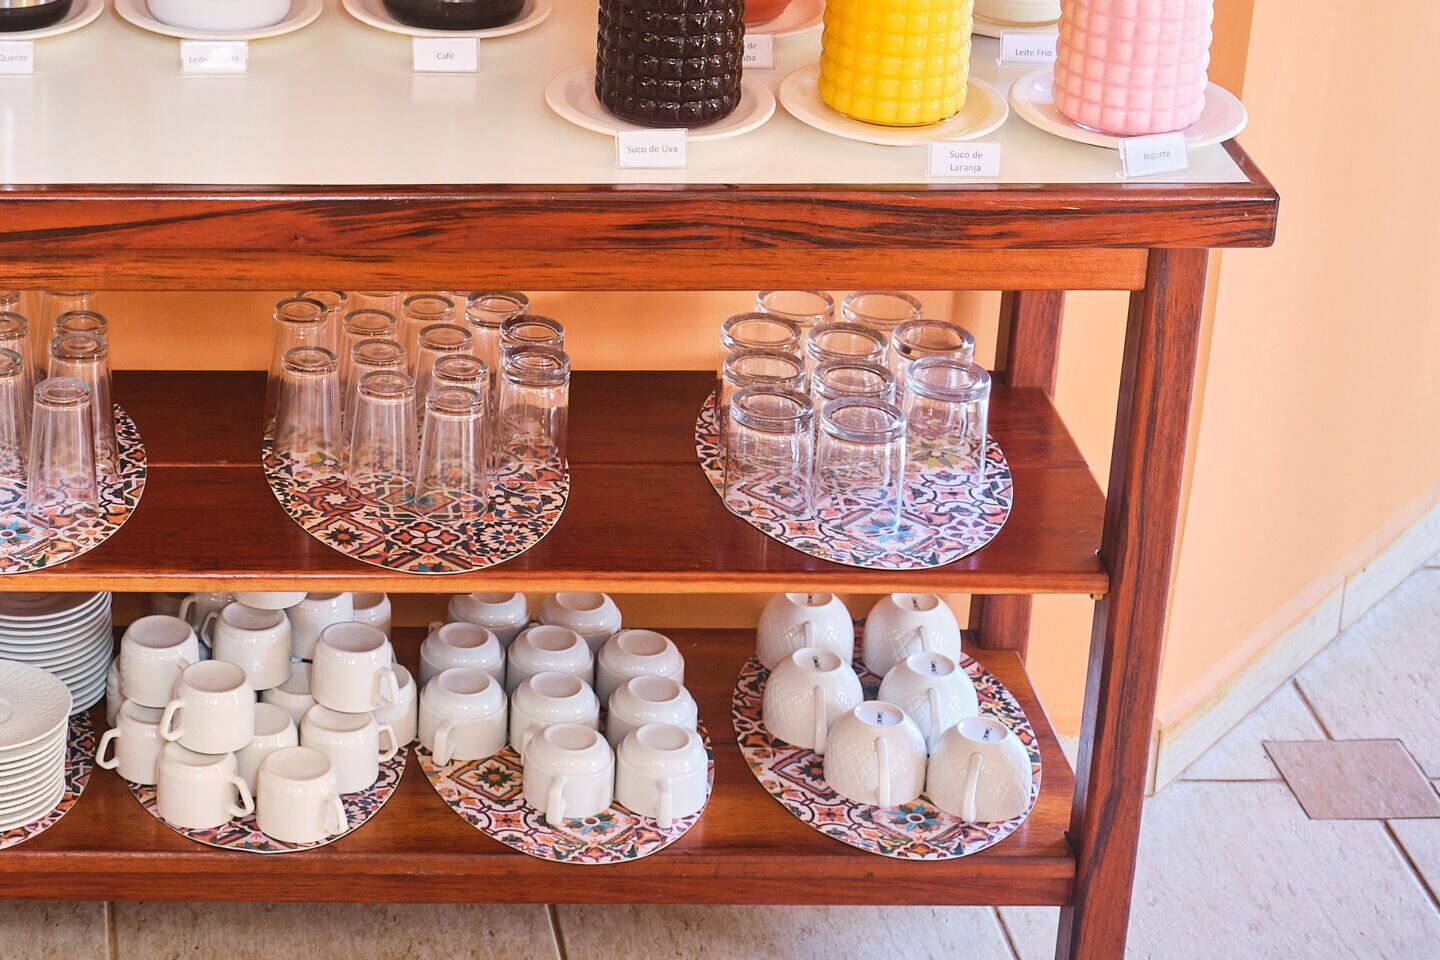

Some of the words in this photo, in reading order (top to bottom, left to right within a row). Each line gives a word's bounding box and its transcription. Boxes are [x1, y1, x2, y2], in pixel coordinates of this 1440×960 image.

[436, 52, 455, 60] Café
[1015, 48, 1035, 57] Leite
[1036, 48, 1053, 57] Frio
[188, 55, 208, 64] Leite
[627, 145, 647, 153] Suco
[648, 144, 660, 153] de
[661, 144, 679, 153] Uva
[949, 150, 970, 159] Suco
[972, 149, 983, 159] de
[1143, 150, 1172, 160] Iogurte
[950, 163, 982, 173] Laranja
